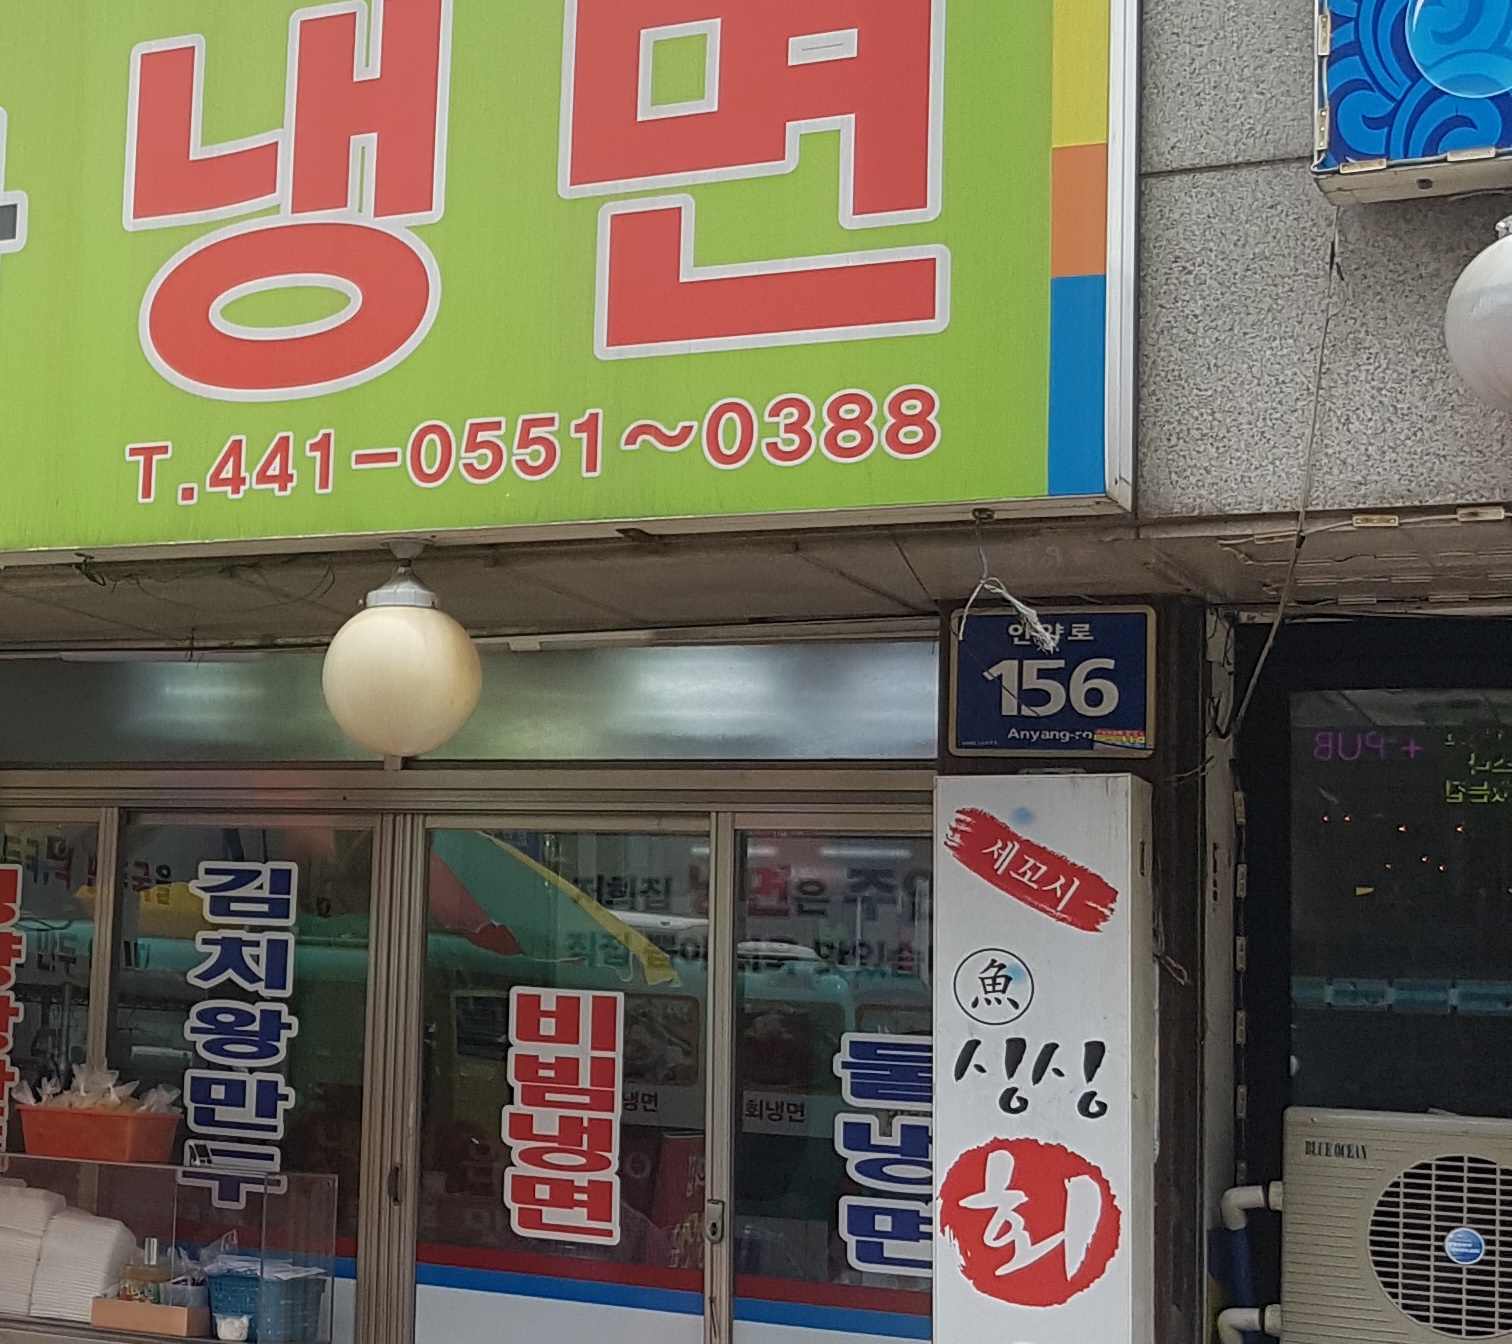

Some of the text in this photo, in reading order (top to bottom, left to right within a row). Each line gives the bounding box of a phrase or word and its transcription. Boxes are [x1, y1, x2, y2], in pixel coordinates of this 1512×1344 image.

[982, 657, 1119, 717] 156
[1007, 727, 1094, 742] Anyang-ro
[982, 835, 1083, 915] 세꼬시
[971, 958, 1021, 1011] 魚
[177, 861, 299, 1210] 김치왕만두
[622, 1091, 660, 1115] 냉면
[954, 1037, 1109, 1120] 싱싱
[502, 986, 624, 1245] 비빔냉면
[744, 1098, 807, 1125] 회냉면
[1304, 1140, 1368, 1160] BLUE OCEAN
[958, 1148, 1103, 1284] 회
